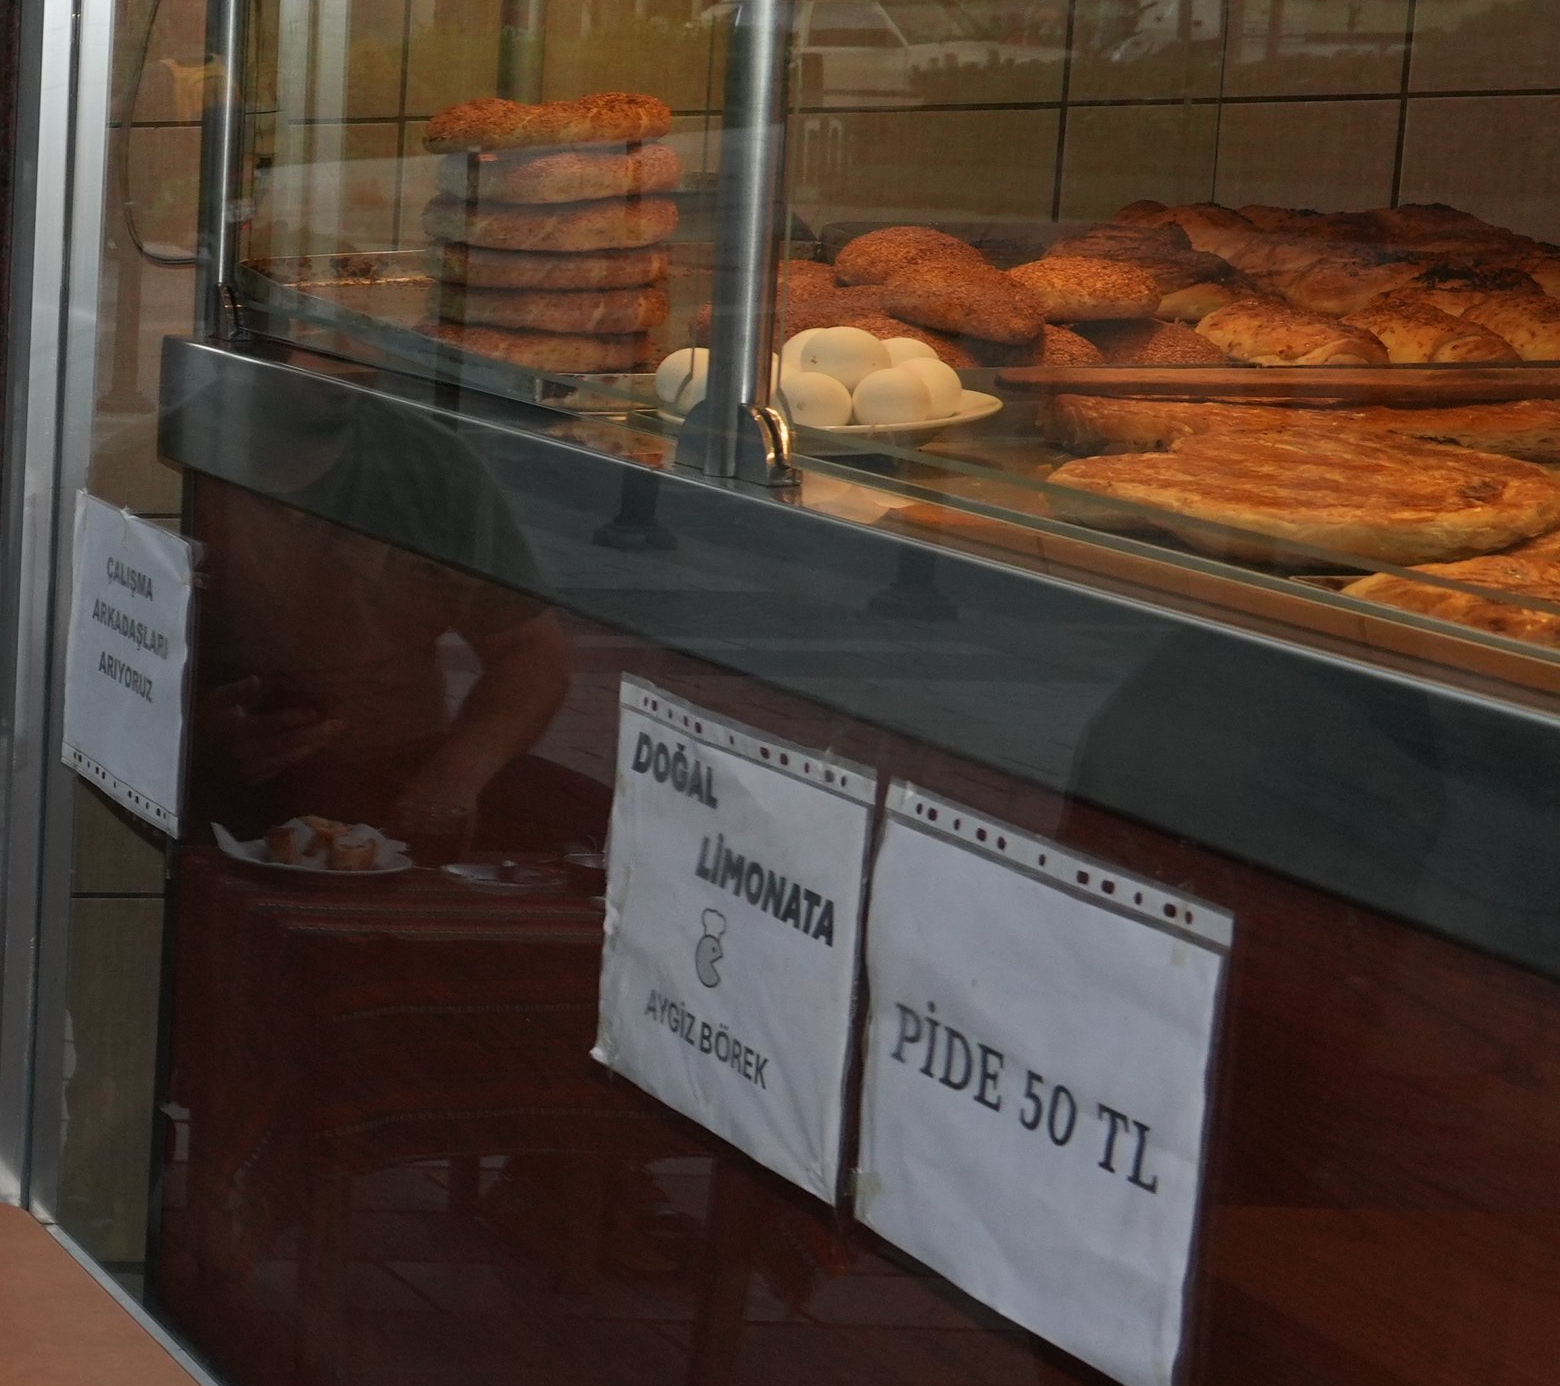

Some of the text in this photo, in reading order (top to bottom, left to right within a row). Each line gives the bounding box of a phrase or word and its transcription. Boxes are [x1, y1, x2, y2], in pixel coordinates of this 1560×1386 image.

[105, 555, 154, 603] ÇALIŞMA
[91, 598, 169, 661] ARKADAŞLARI
[98, 650, 154, 704] ARIYORUZ
[630, 731, 719, 810] DOĞAL
[694, 832, 835, 948] LİMONATA
[699, 1017, 770, 1091] BÖREK
[890, 1000, 1160, 1195] PİDE 50 TL
